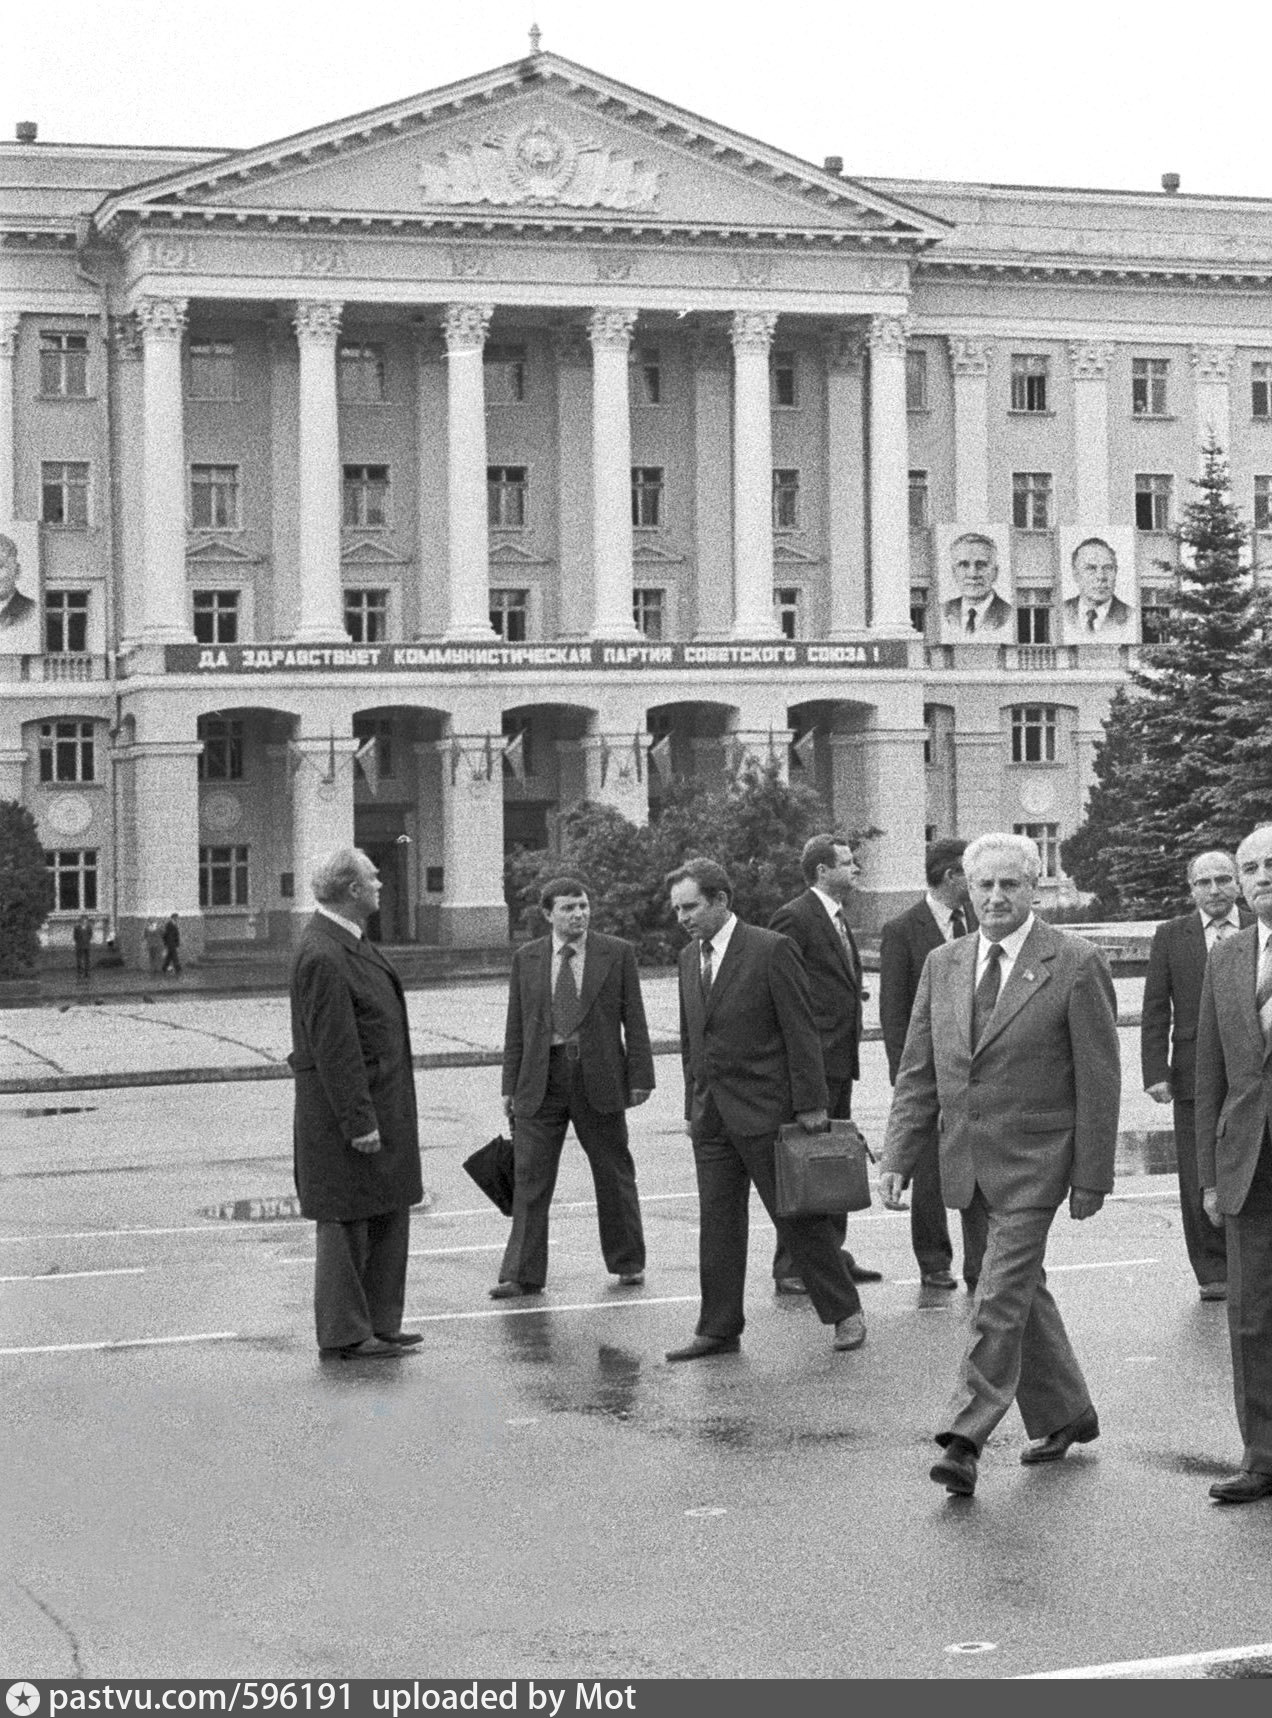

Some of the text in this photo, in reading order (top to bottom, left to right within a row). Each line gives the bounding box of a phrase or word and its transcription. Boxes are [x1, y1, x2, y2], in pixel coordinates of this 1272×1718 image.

[198, 650, 229, 668] ДА
[242, 649, 381, 667] ЗДРАВСТВУЕТ
[393, 648, 592, 665] КОММУНИСТИЧЕСКАЯ
[603, 647, 673, 663] ПАРТИЯ
[683, 646, 797, 663] СОВЕТСКОГО
